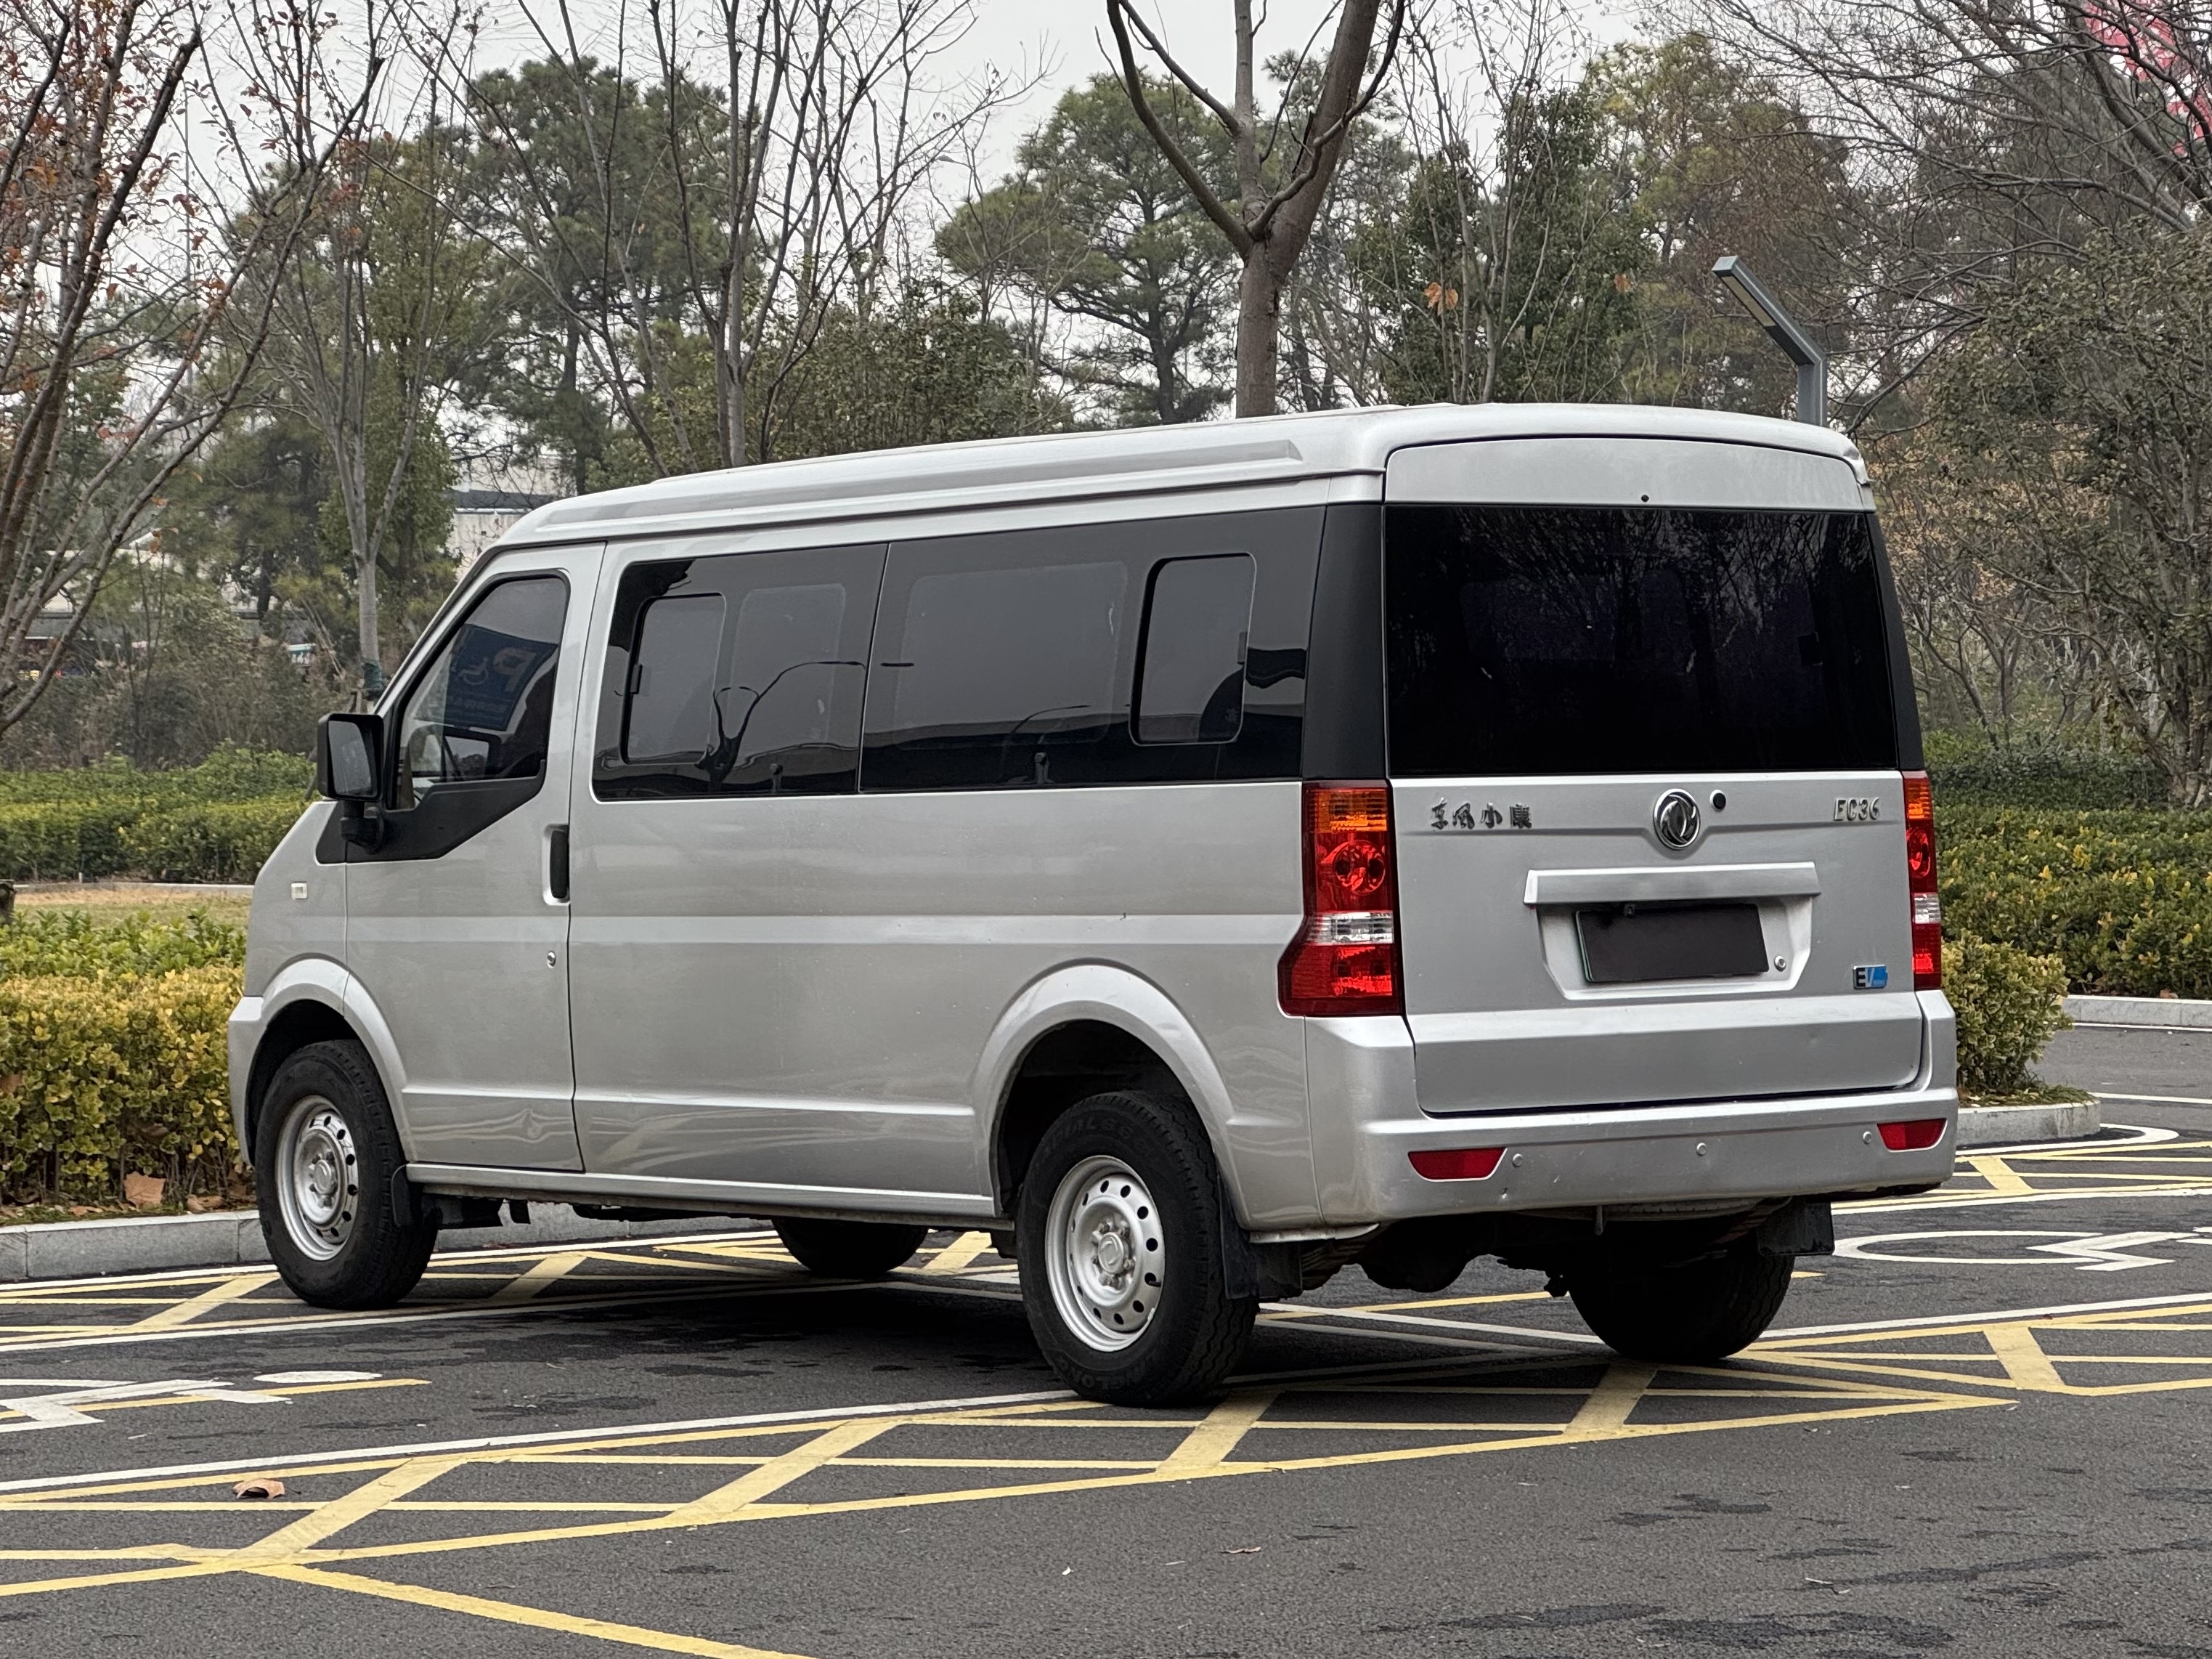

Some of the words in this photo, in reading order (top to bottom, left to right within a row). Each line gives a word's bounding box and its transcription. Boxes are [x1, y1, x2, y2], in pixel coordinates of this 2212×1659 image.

[1431, 797, 1532, 830] 东风小康
[1834, 797, 1879, 821] EC36
[1855, 968, 1875, 988] EV
